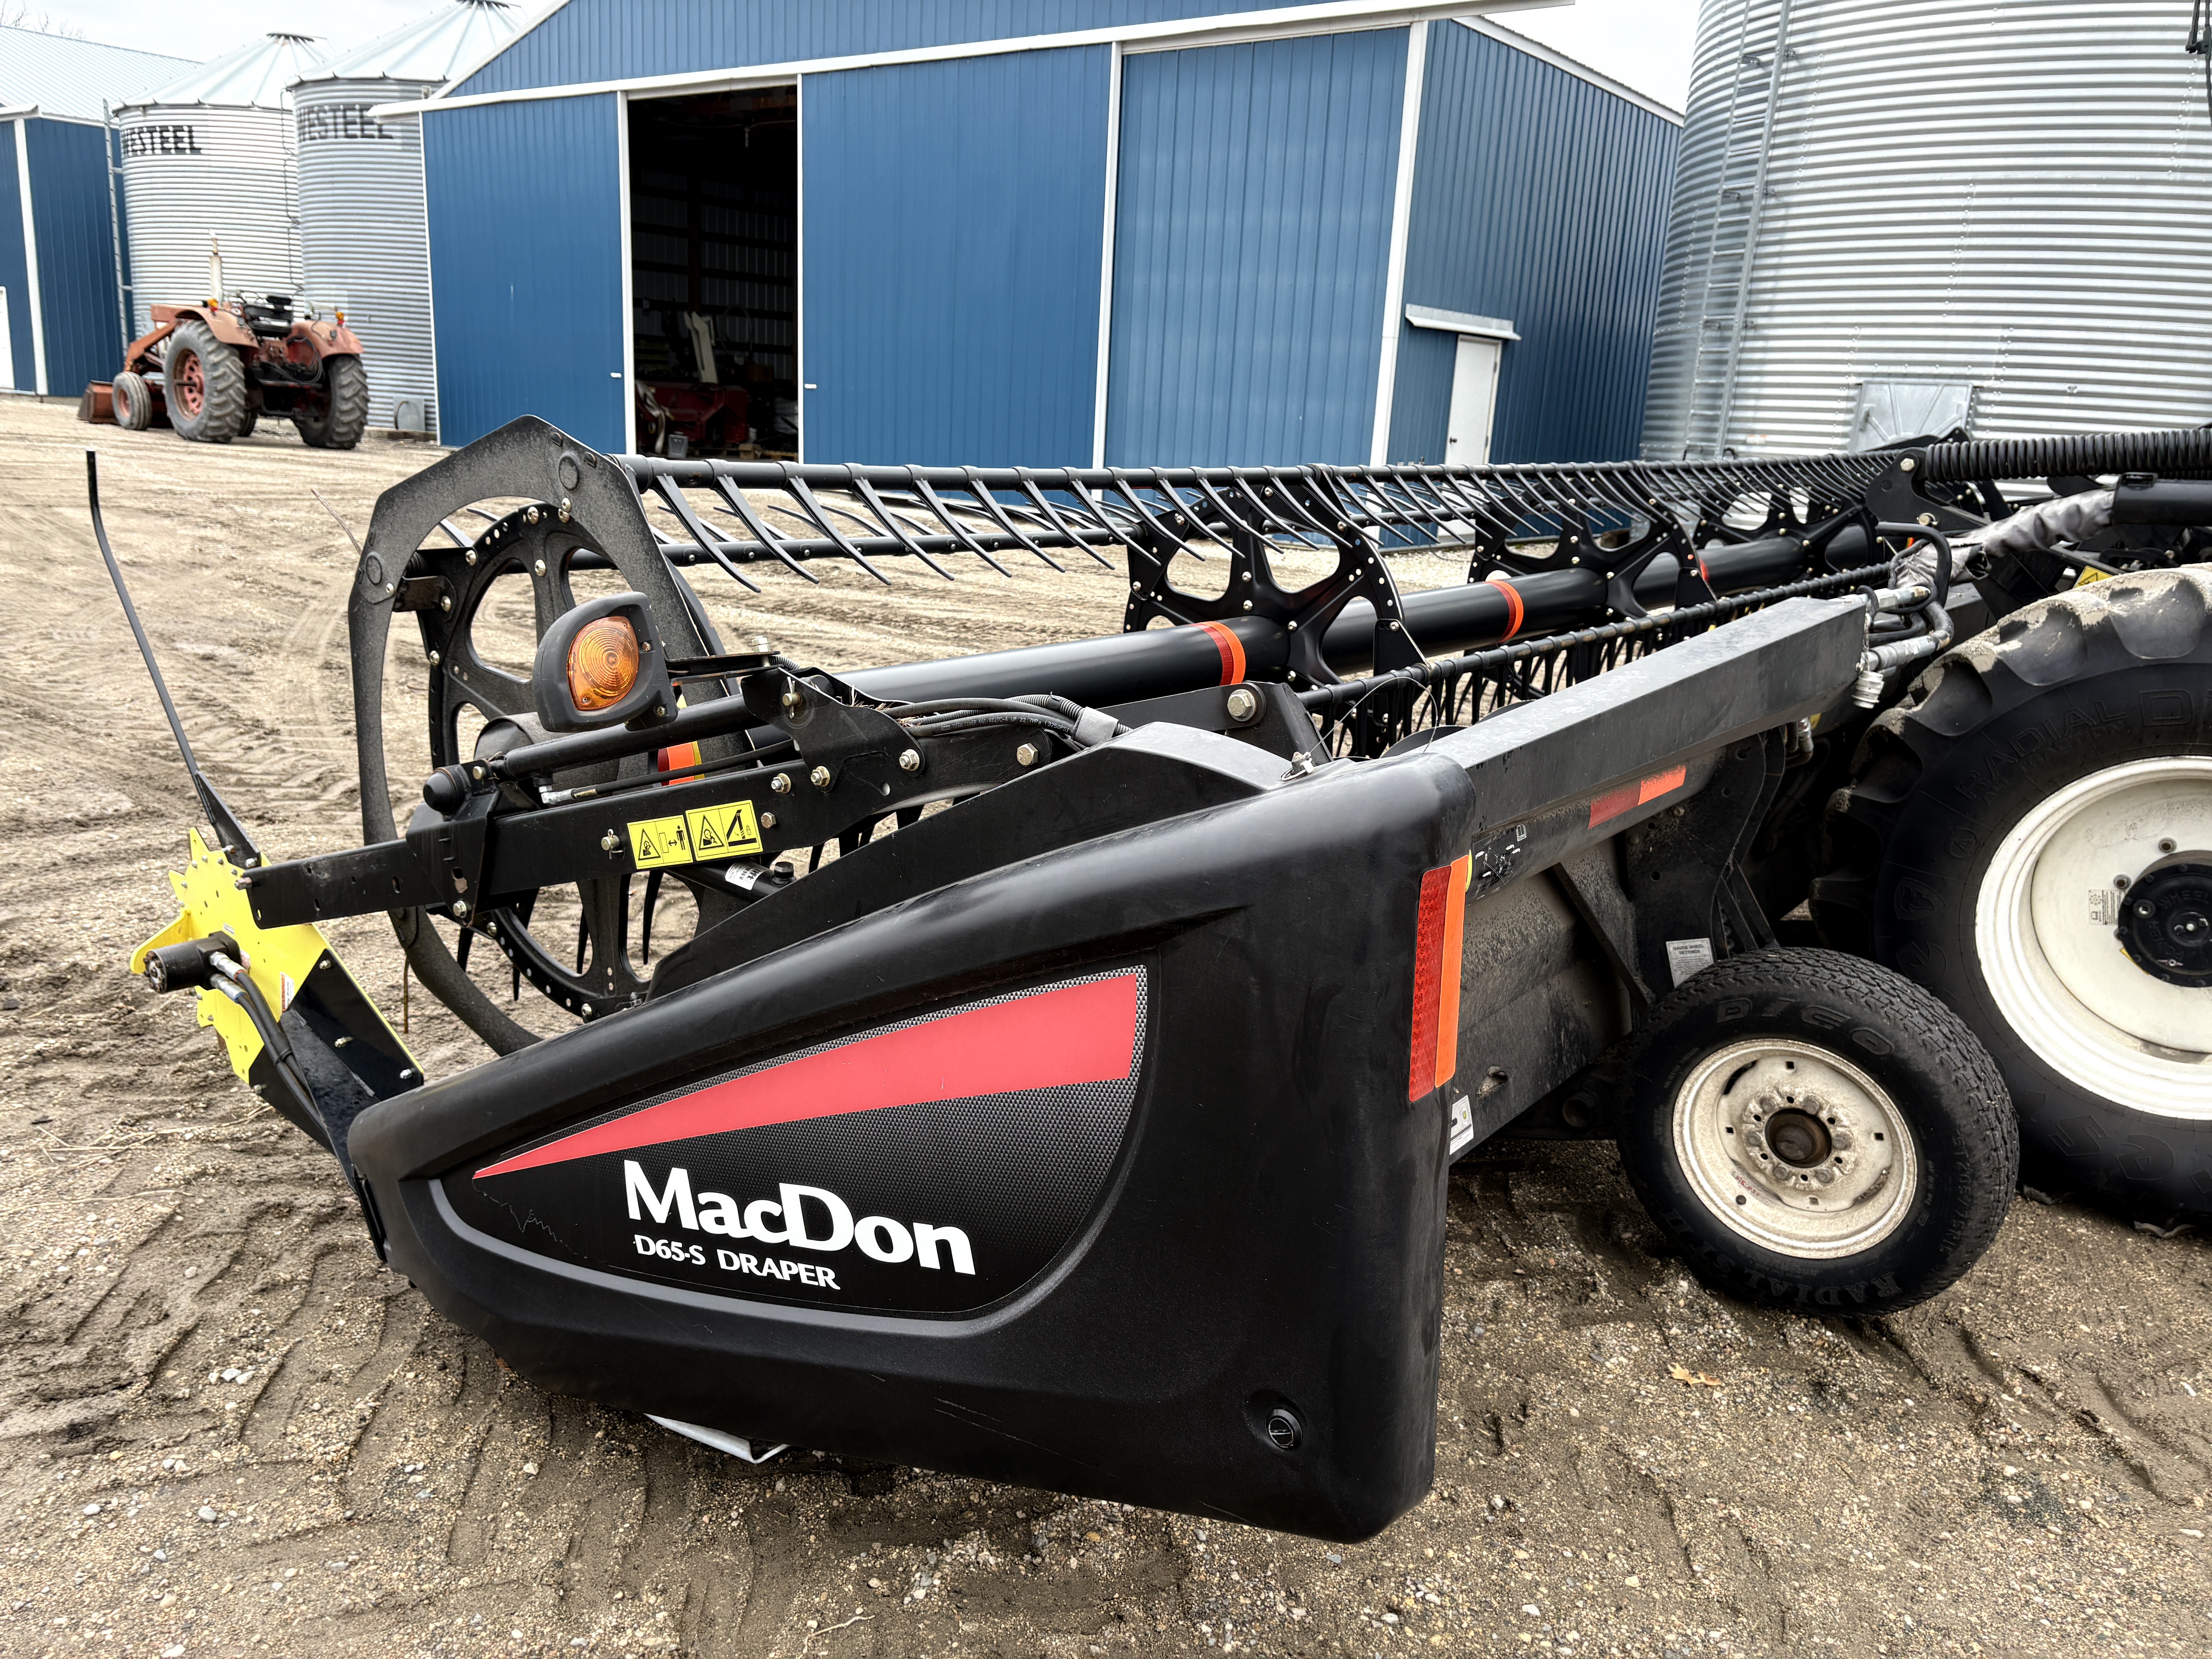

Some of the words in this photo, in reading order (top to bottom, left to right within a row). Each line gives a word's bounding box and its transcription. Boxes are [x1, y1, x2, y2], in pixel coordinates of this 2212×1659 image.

[1954, 700, 2128, 800] RADIAL
[2156, 890, 2210, 909] WHEEL
[624, 1160, 975, 1275] MacDon
[634, 1234, 706, 1265] D65-S
[716, 1249, 841, 1290] DRAPER
